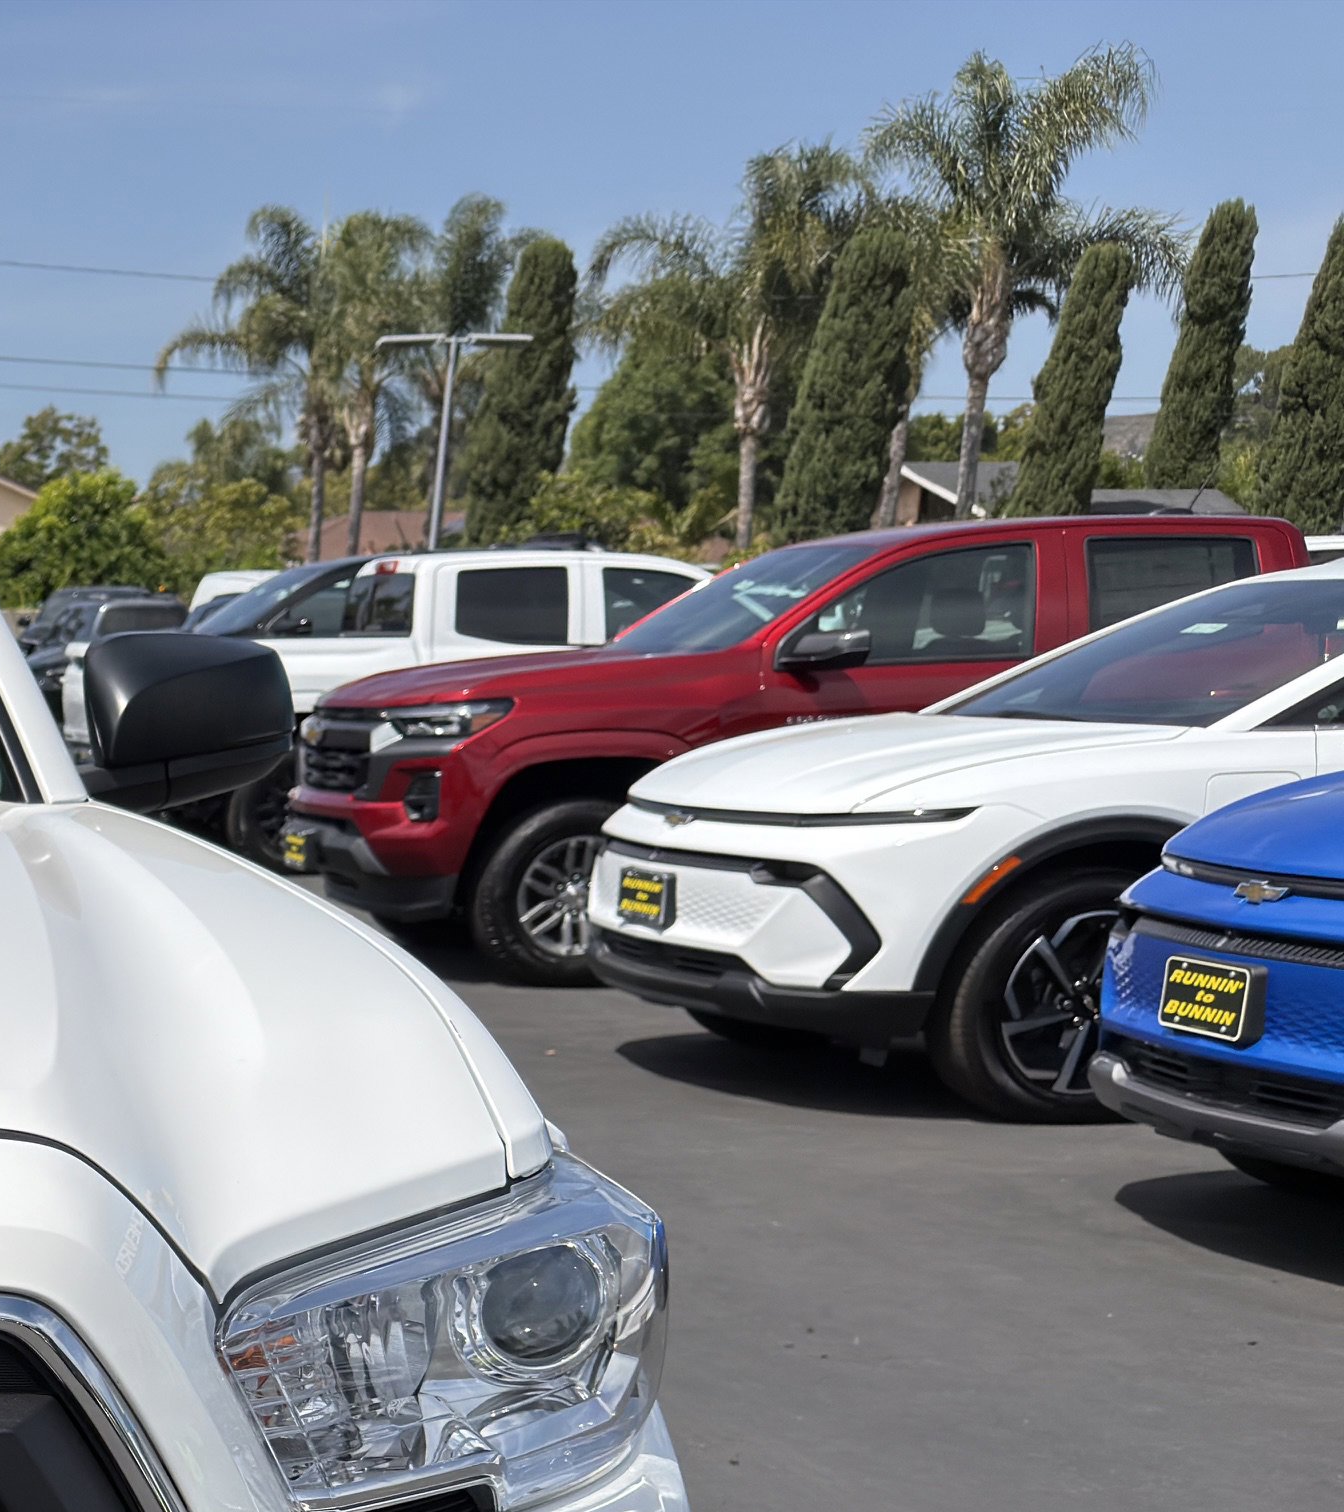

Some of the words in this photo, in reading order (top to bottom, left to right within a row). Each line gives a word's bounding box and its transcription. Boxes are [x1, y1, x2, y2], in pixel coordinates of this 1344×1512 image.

[1169, 969, 1245, 994] RUNNIN'
[1195, 990, 1215, 1004] to
[1163, 999, 1237, 1027] BUNNIN
